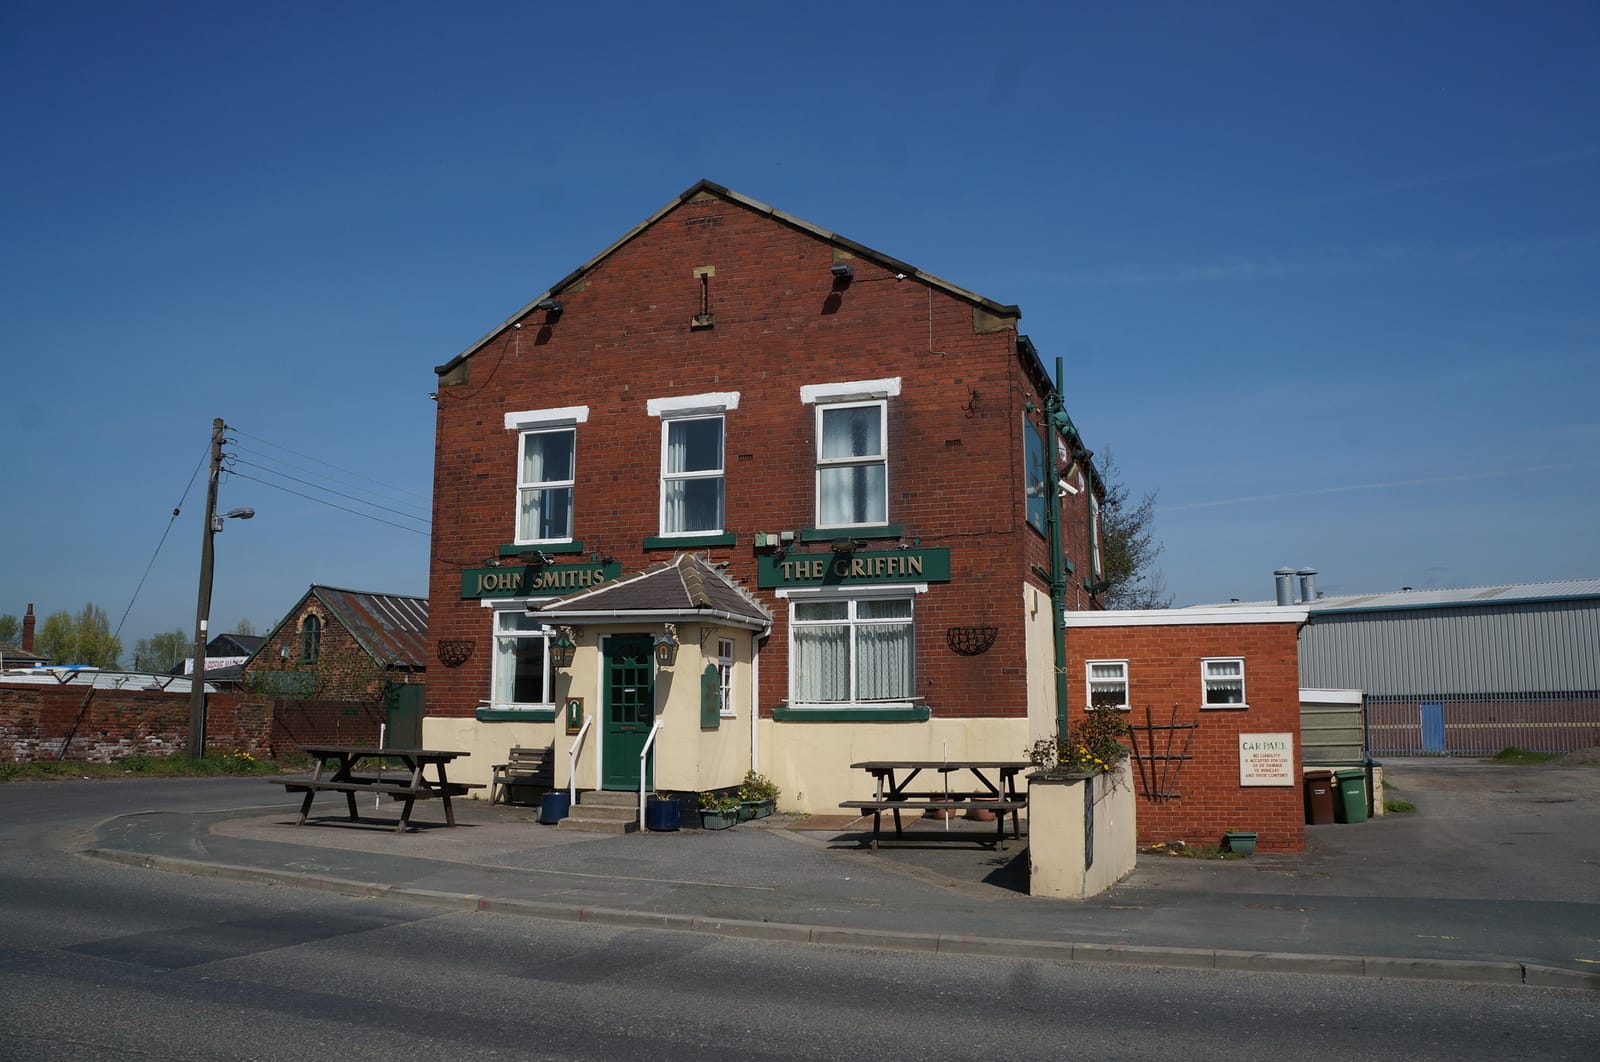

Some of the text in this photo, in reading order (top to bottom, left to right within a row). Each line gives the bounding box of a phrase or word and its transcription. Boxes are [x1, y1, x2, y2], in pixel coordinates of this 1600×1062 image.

[780, 555, 923, 580] THE GRIFFIN
[476, 569, 605, 595] JOHN SMITHS
[1242, 741, 1261, 750] CAR
